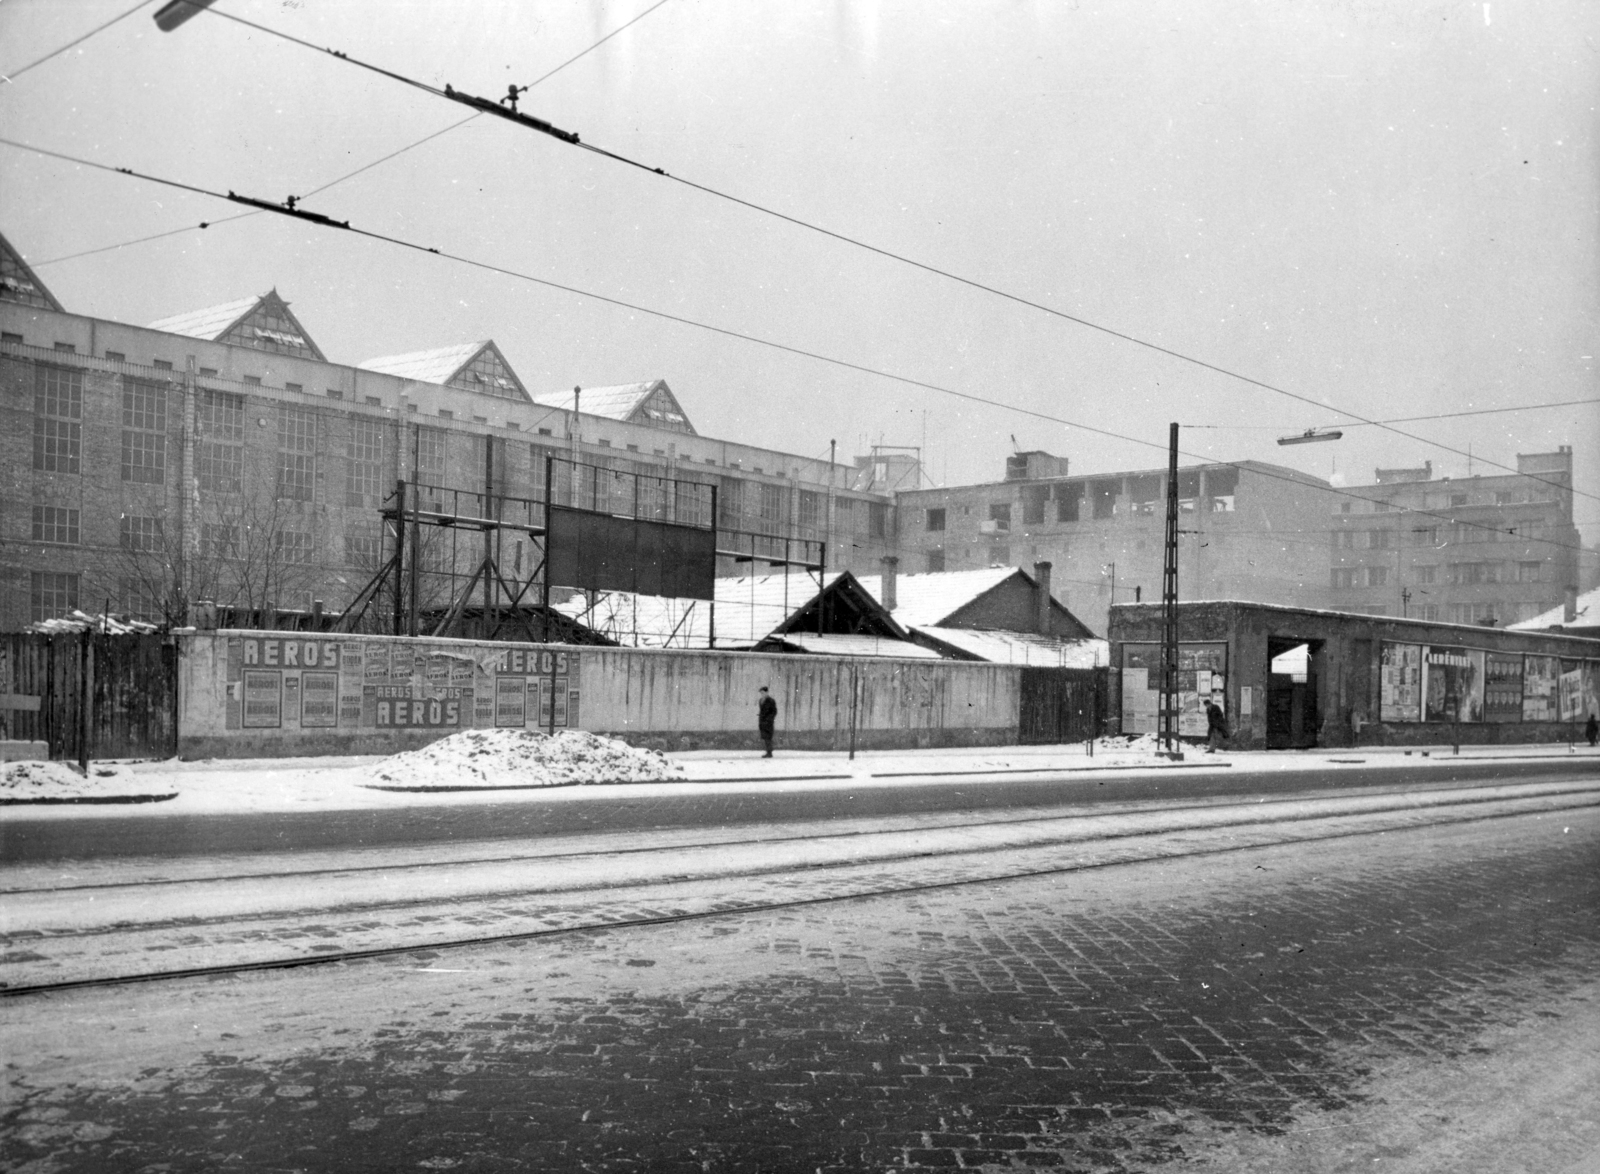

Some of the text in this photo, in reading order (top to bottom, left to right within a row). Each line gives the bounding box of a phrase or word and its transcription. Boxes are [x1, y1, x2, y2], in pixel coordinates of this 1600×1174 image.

[243, 641, 337, 667] AEROS
[496, 650, 567, 674] AEROS
[377, 687, 410, 698] AEROS
[378, 701, 459, 724] AEROS
